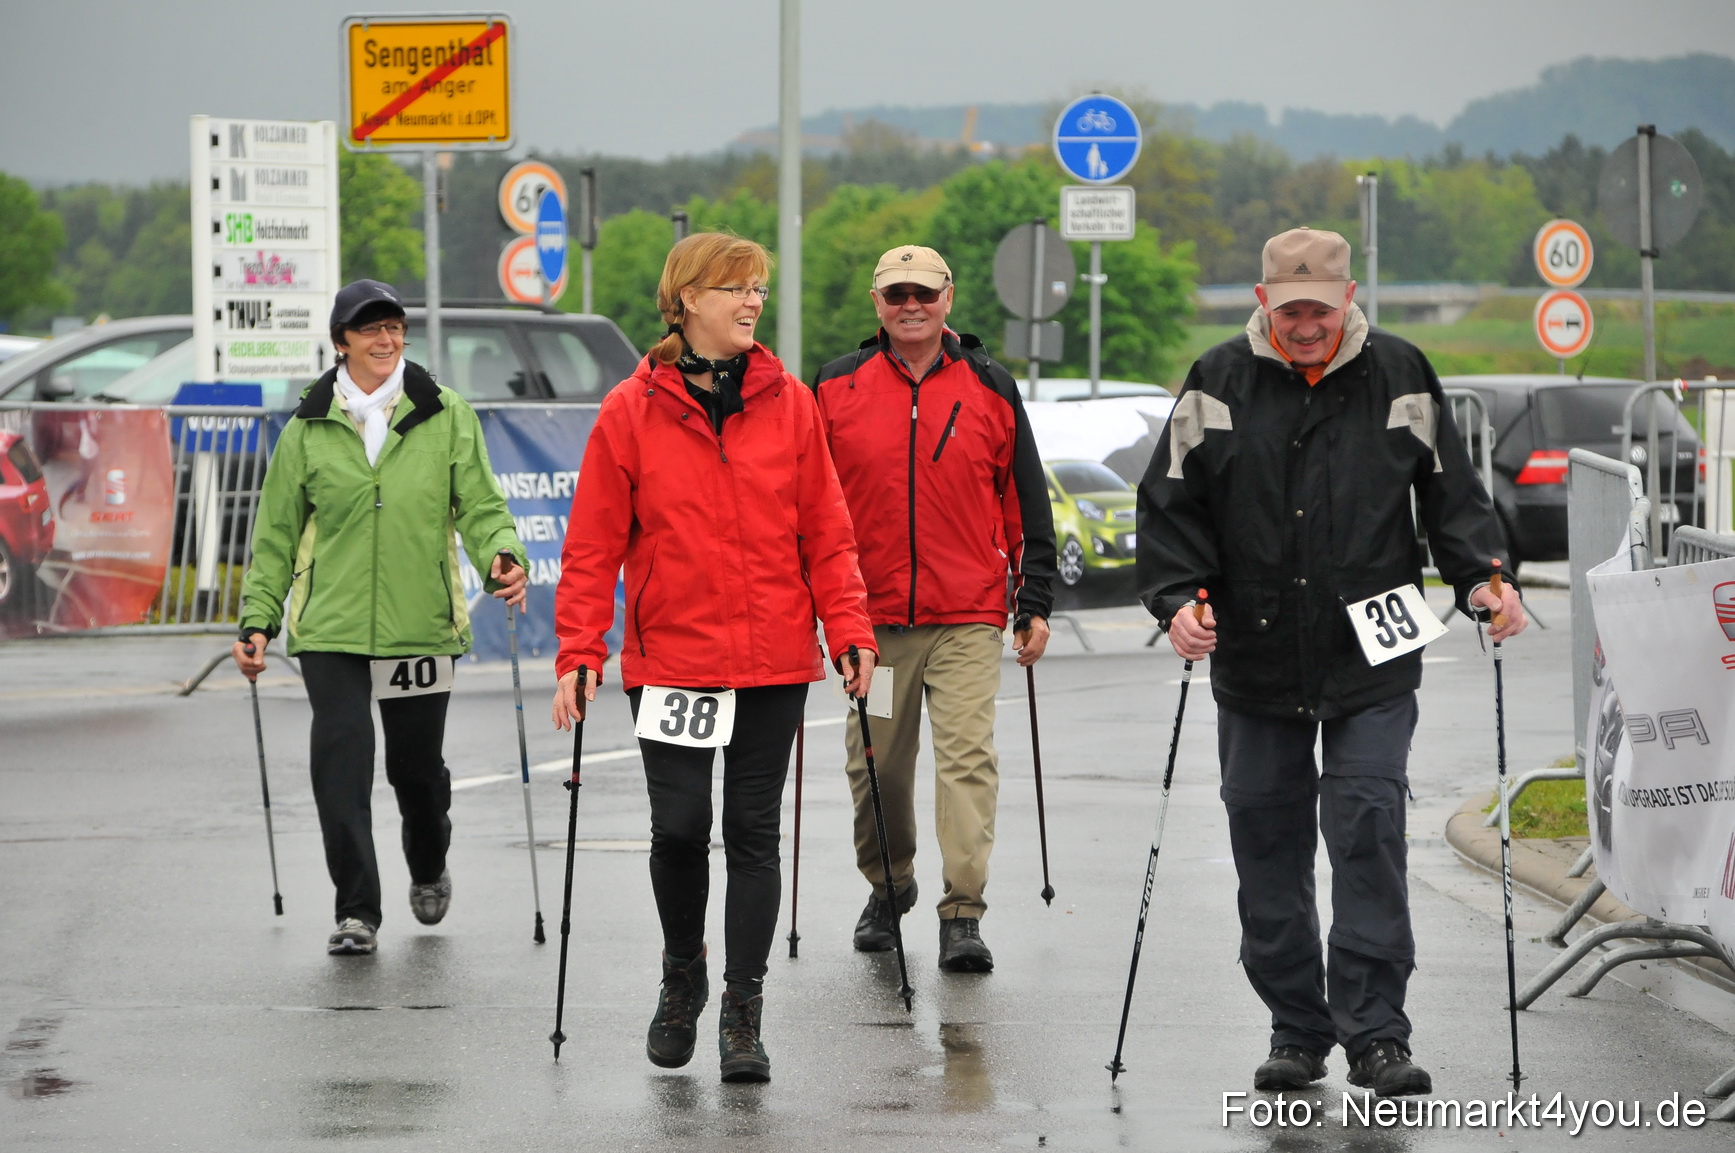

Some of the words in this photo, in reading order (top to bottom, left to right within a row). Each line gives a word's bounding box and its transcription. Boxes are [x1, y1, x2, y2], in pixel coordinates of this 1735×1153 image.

[364, 38, 493, 75] Sengenthal
[381, 79, 409, 94] am
[420, 77, 475, 97] Anger
[396, 111, 452, 126] Neumarkt
[226, 213, 254, 245] SHB
[255, 218, 309, 241] Holzfachmarkt
[1550, 239, 1580, 268] 60
[227, 300, 272, 330] THULE
[1365, 592, 1420, 649] 39
[390, 656, 437, 691] 40
[660, 691, 718, 740] 38
[1628, 787, 1675, 808] UPGRADE
[1672, 784, 1697, 806] IST
